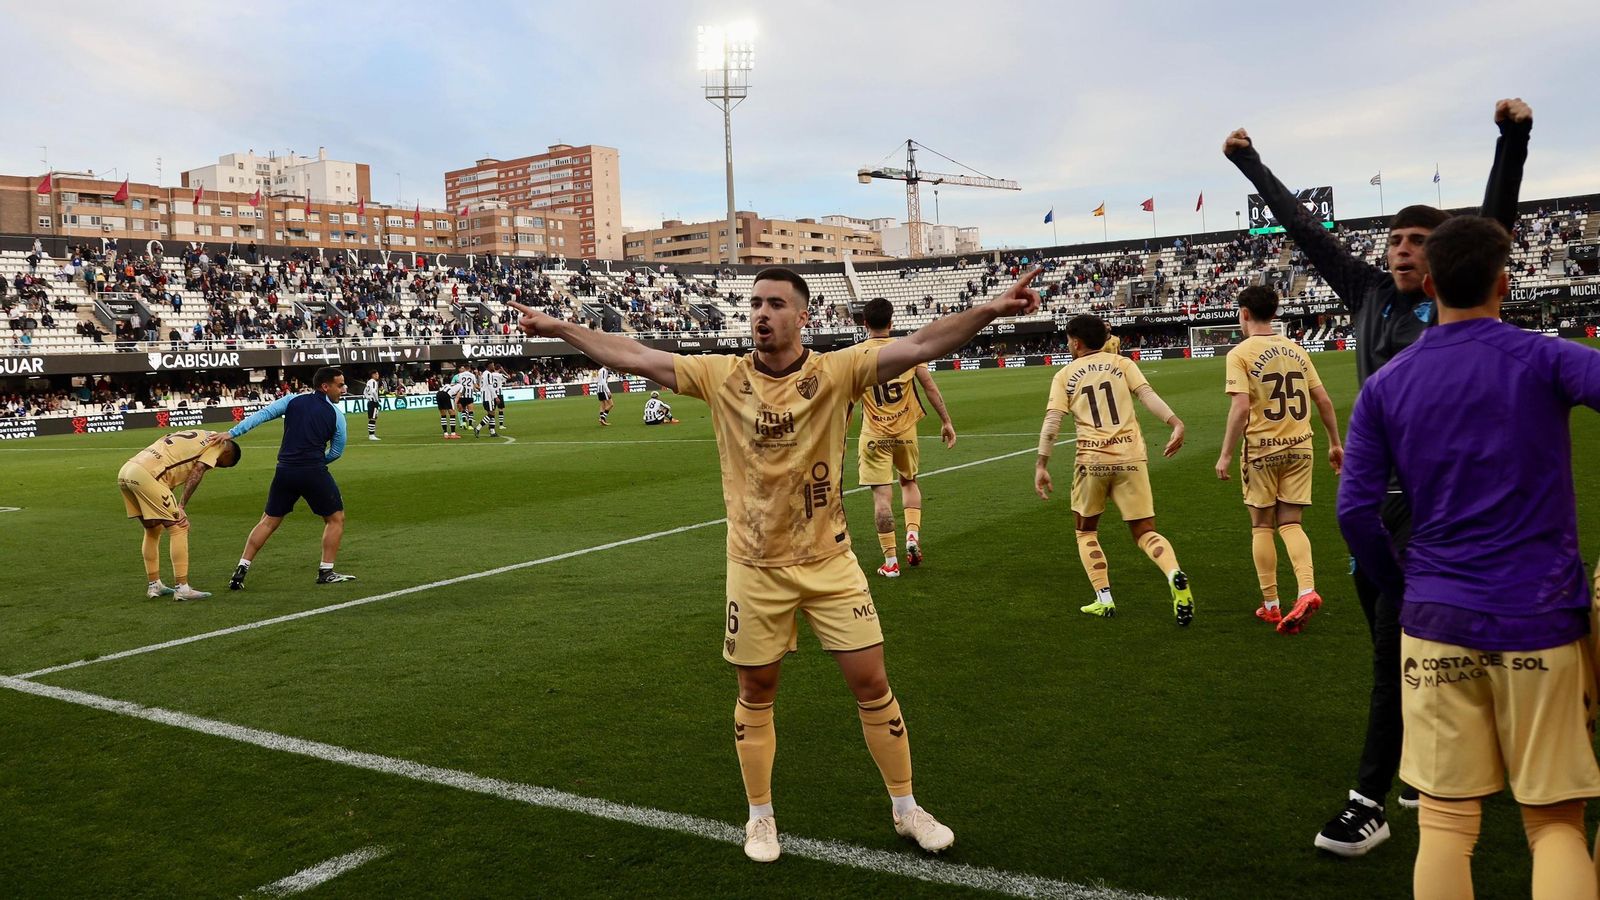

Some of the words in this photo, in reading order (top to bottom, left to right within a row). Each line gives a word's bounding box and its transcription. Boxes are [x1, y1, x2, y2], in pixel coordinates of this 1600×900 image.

[1252, 207, 1259, 220] 0
[1321, 201, 1329, 214] 0
[1511, 289, 1526, 300] FCC
[1570, 284, 1600, 297] MUCH
[1195, 311, 1235, 320] CABISUAR
[350, 350, 357, 360] 0
[362, 350, 367, 360] 1
[471, 344, 523, 357] CABISUAR
[162, 352, 240, 368] CABISUAR
[1251, 347, 1280, 378] AARON
[461, 376, 472, 387] 22
[1066, 367, 1086, 397] KEVIN
[1261, 371, 1308, 421] 35
[1081, 380, 1120, 429] 11
[727, 600, 739, 634] 6
[1422, 656, 1475, 671] COSTA
[1478, 655, 1508, 669] DEL
[1512, 657, 1549, 671] SOL
